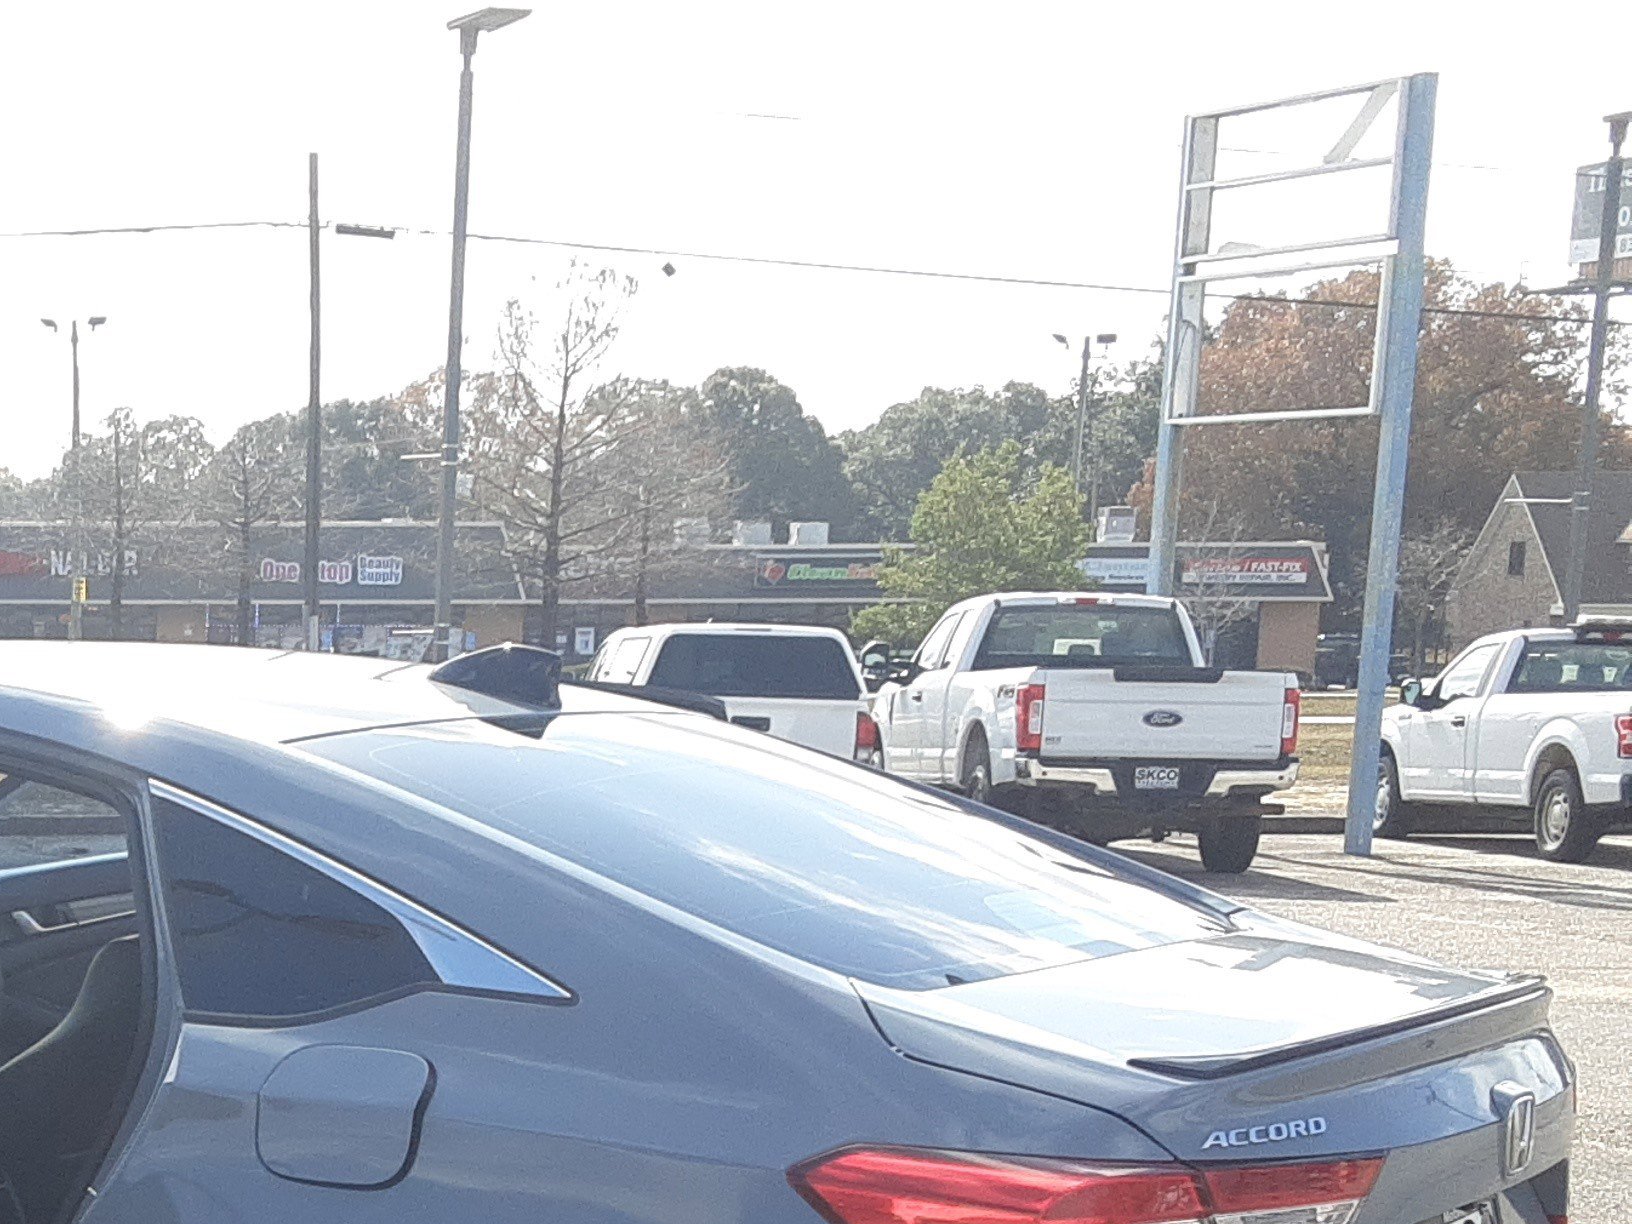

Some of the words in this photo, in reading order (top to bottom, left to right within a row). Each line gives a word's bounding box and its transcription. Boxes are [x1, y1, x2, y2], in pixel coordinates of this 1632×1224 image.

[262, 558, 299, 582] One
[319, 560, 352, 583] top
[359, 568, 401, 583] Supply
[1135, 769, 1178, 781] SKCO
[1201, 1117, 1327, 1151] ACCORD
